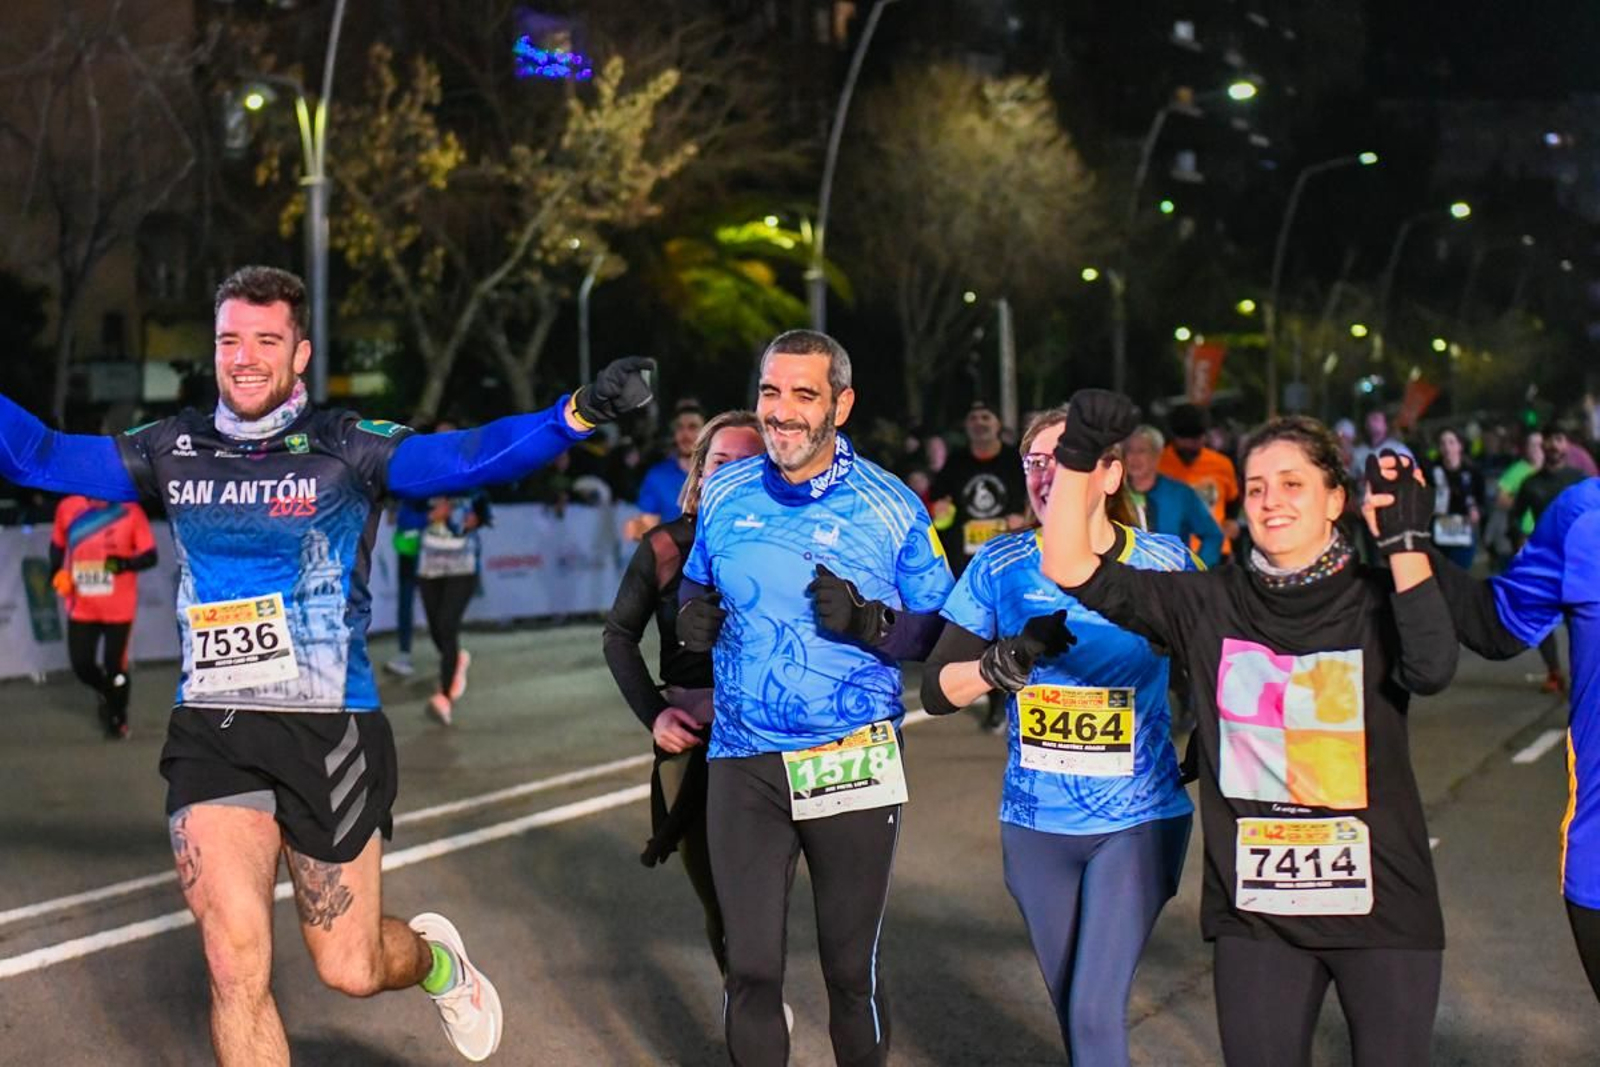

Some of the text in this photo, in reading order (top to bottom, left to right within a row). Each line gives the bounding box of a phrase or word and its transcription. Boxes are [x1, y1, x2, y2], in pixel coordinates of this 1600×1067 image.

[168, 472, 318, 505] SAN ANTÓN
[268, 496, 319, 518] 2025
[196, 622, 279, 658] 7536
[1041, 689, 1061, 705] 42
[1028, 708, 1124, 742] 3464
[797, 746, 888, 791] 1578
[1263, 824, 1284, 840] 42
[1249, 846, 1357, 879] 7414
